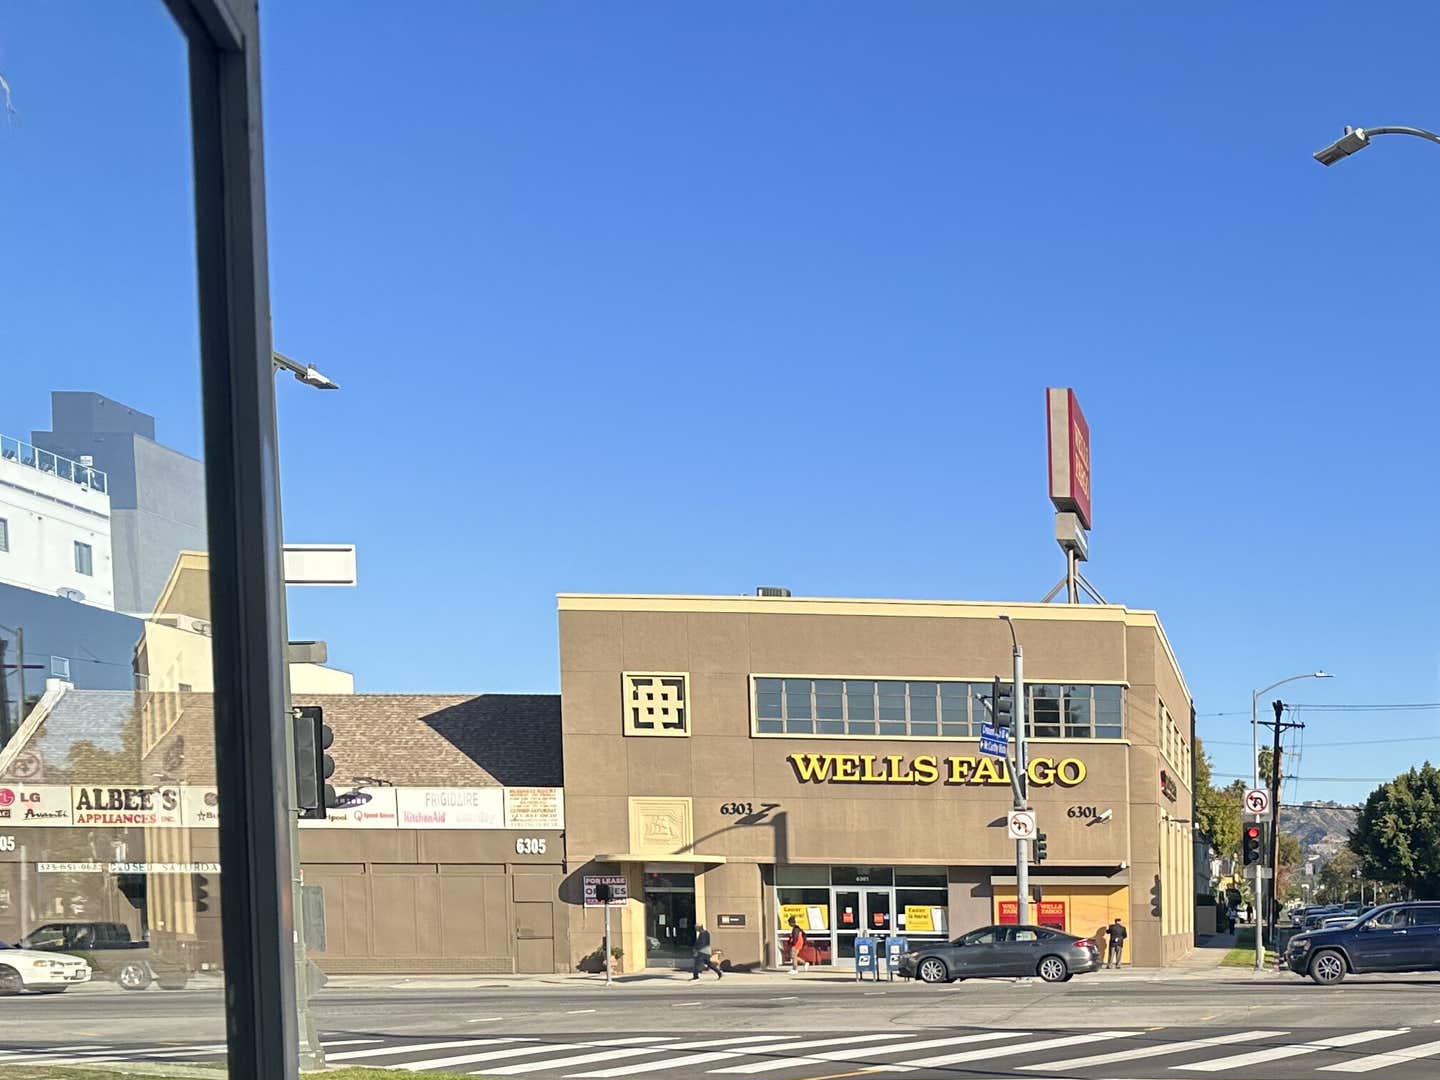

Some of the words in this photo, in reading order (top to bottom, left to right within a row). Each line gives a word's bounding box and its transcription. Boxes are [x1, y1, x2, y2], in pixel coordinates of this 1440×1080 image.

[788, 753, 939, 785] WELLS
[20, 792, 40, 802] LG
[23, 808, 69, 820] Avanti
[720, 802, 753, 815] 6303
[1067, 806, 1097, 818] 6301
[77, 814, 157, 824] APPLIANCES
[516, 838, 546, 854] 6305
[111, 863, 153, 871] CLOSED
[163, 863, 218, 871] SATURDA
[585, 877, 601, 885] FOR
[602, 877, 625, 885] LEASE
